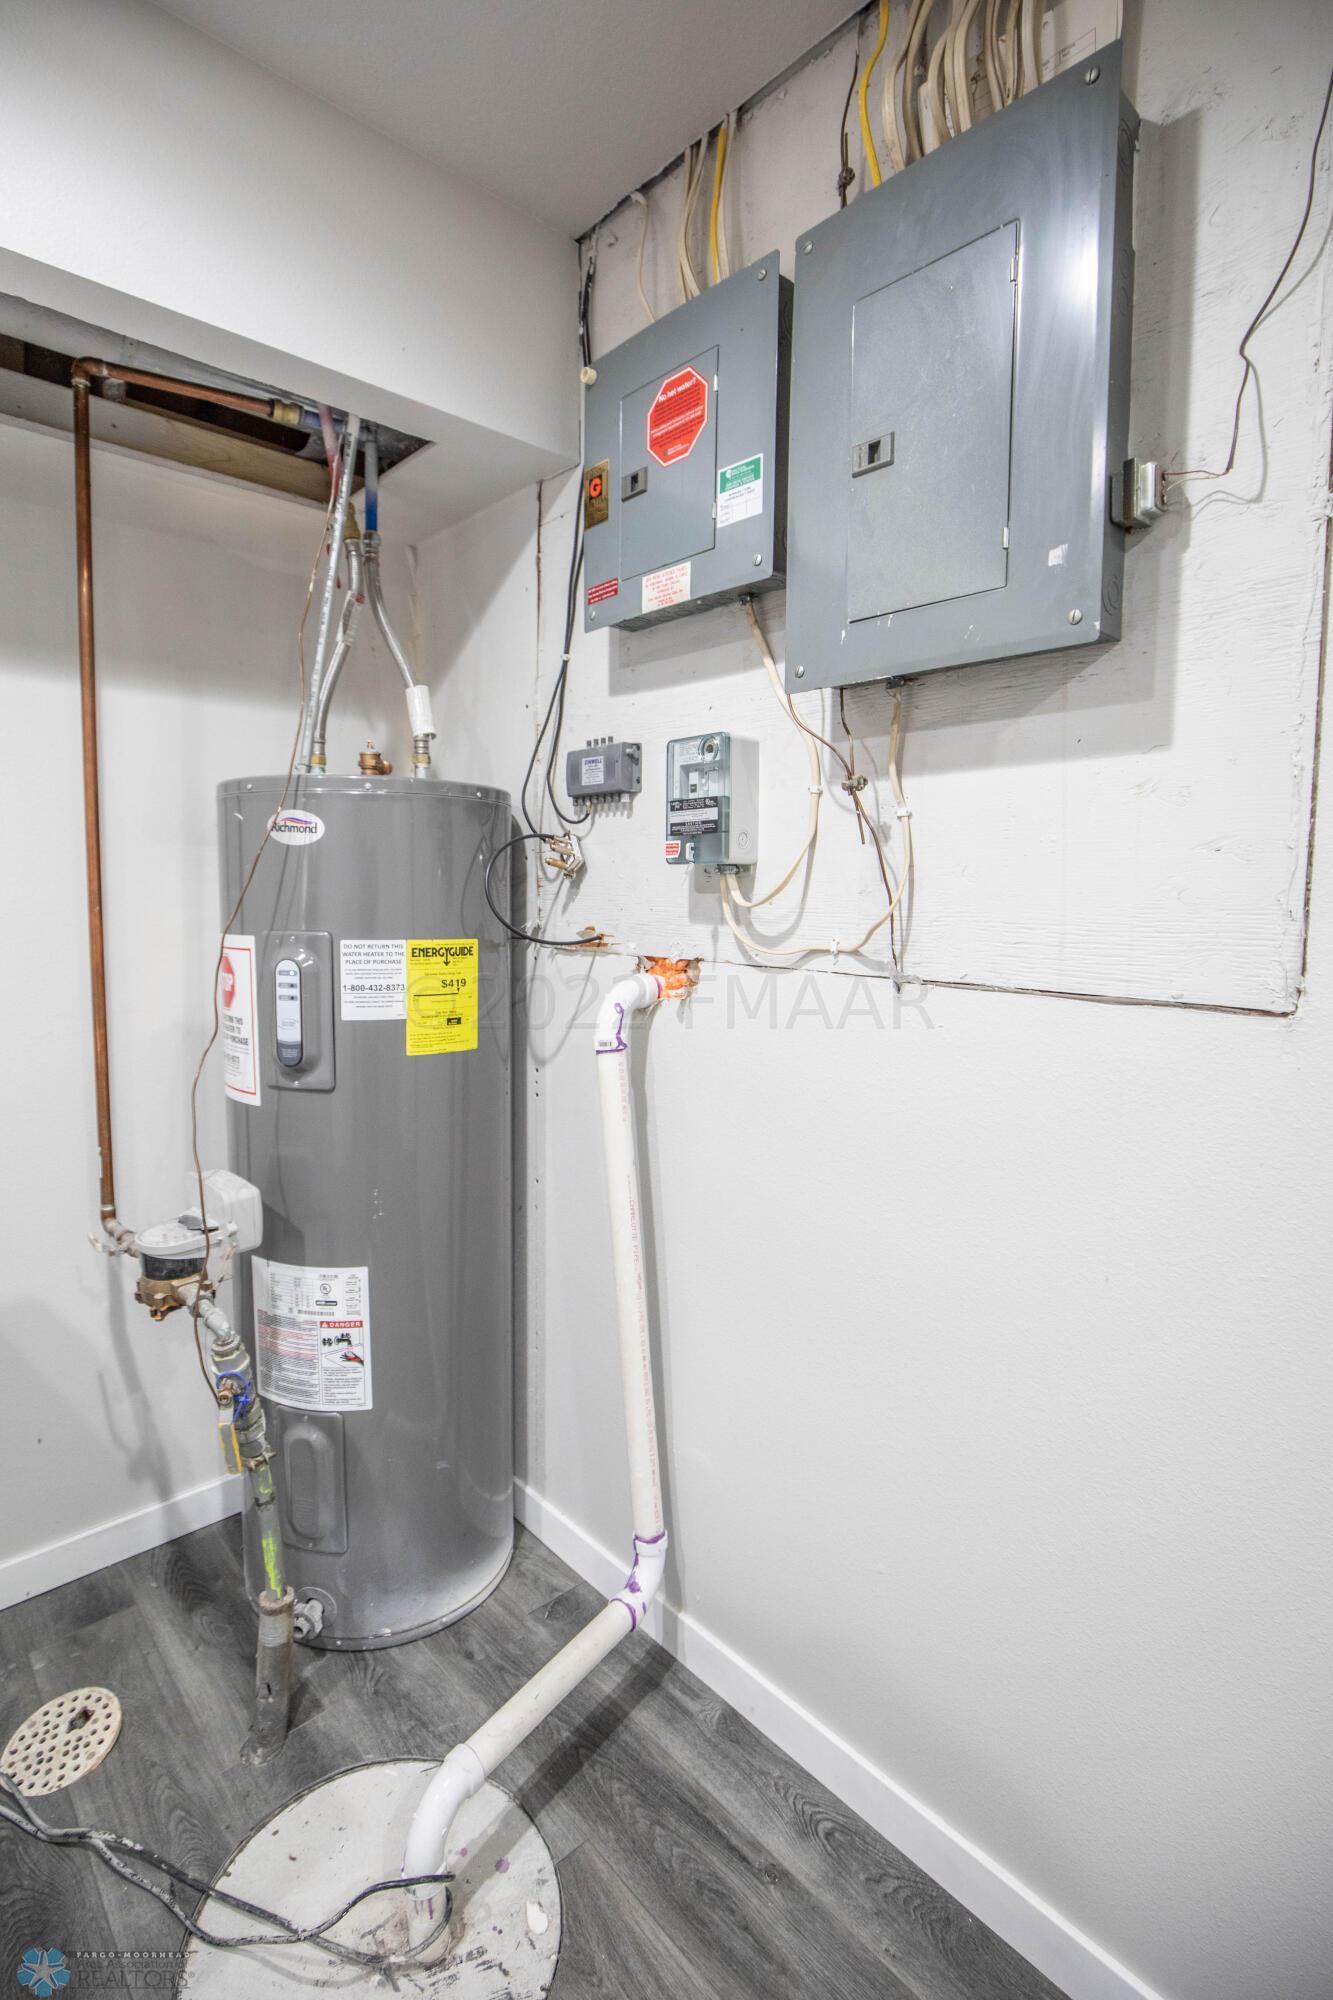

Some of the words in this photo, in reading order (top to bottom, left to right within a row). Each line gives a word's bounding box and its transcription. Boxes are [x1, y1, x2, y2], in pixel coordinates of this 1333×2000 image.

[658, 393, 667, 402] No
[667, 387, 677, 398] hot
[677, 376, 697, 392] water?
[411, 945, 474, 958] ENERGYGUIDE
[343, 984, 406, 992] 1-800-432-8373
